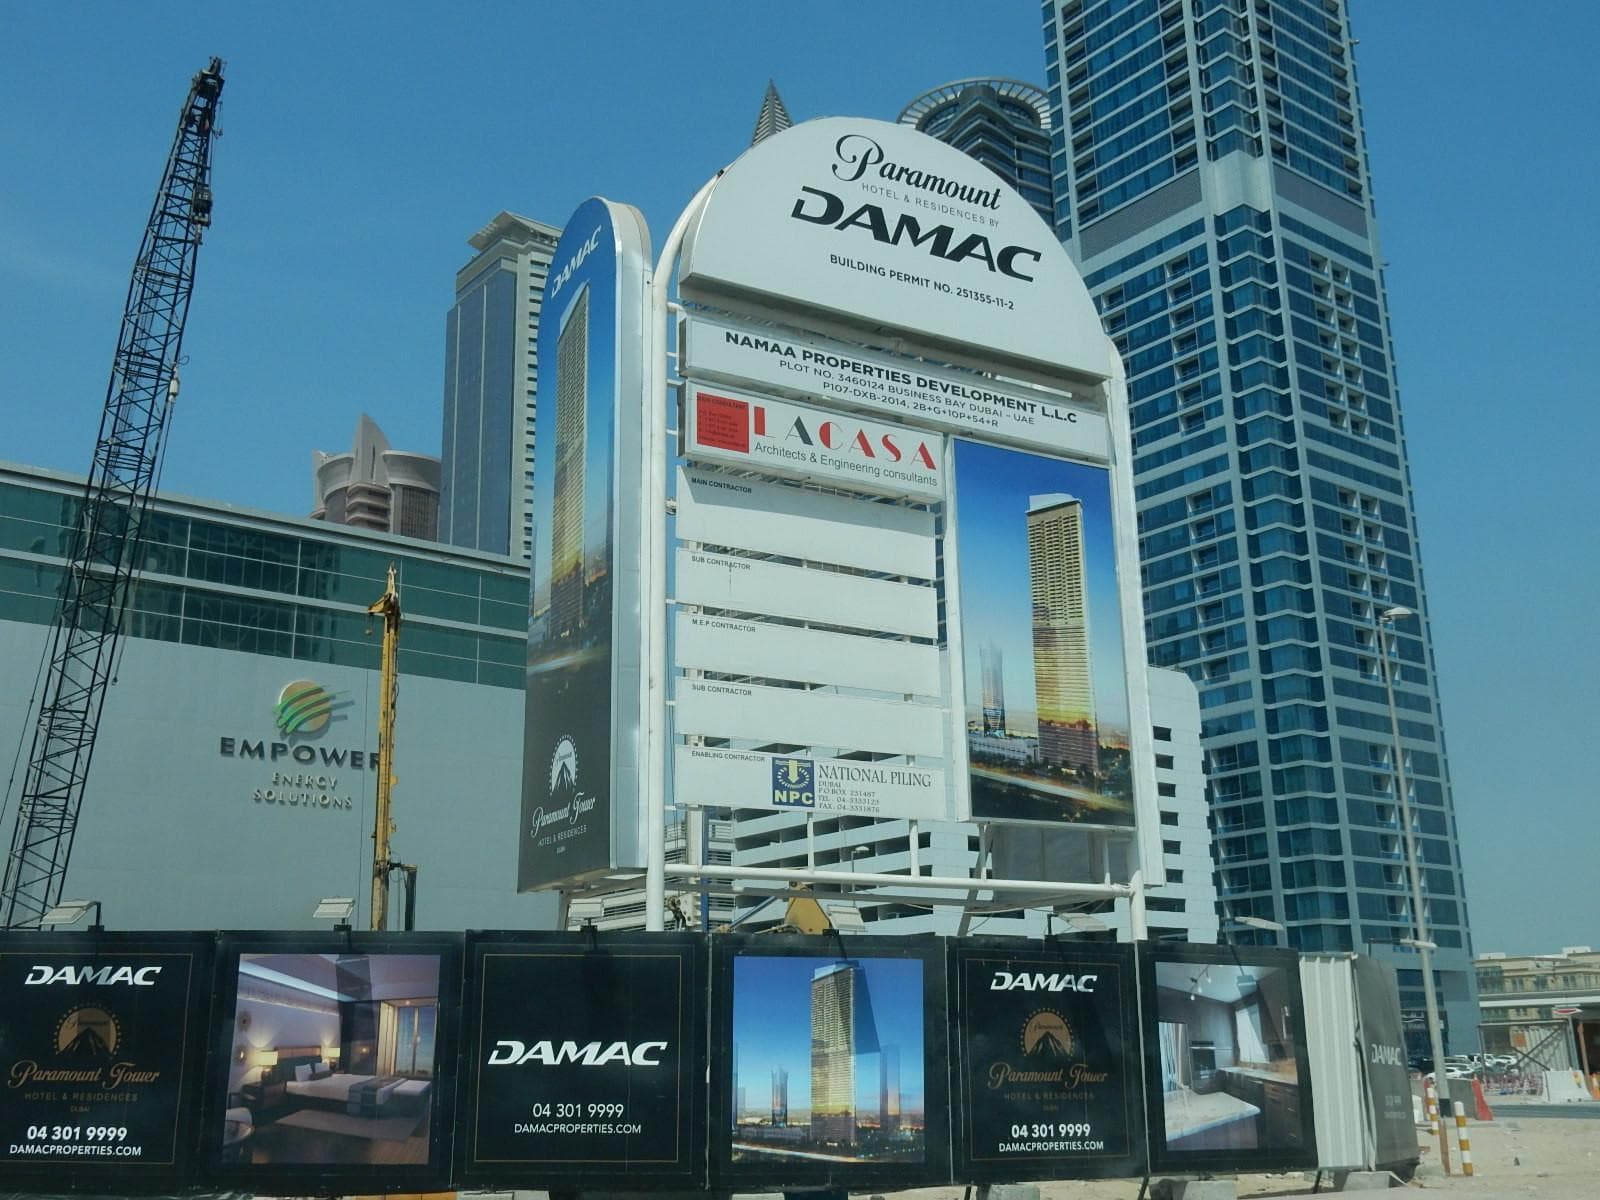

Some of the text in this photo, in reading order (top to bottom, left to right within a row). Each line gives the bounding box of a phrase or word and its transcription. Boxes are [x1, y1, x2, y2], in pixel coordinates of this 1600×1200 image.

[831, 134, 1001, 210] Paramount
[861, 182, 1000, 229] HOTEL & RESIDENCES BY
[790, 185, 1042, 283] DAMAC
[550, 224, 602, 299] DAMAC
[829, 253, 1015, 311] BUILDING PERMIT NO. 251355-11-2
[725, 331, 1078, 424] NAMAA PROPERTIES DEVELOPMENT L.L.C
[779, 359, 811, 374] PLOT
[813, 368, 835, 380] NO.
[837, 373, 885, 392] 3460124
[888, 385, 942, 404] BUSINESS
[944, 398, 966, 410] BAY
[969, 403, 1003, 418] DUBAI
[1013, 413, 1035, 425] UAE
[823, 381, 999, 428] P107-DXB-2014, 2B+G+10P+54+R
[754, 405, 937, 471] LACASA
[754, 441, 938, 488] Architects & Engineering consultants
[691, 477, 752, 494] MAIN CONTRACTOR
[691, 555, 751, 570] SUB CONTRACTOR
[711, 621, 756, 633] CONTRACTOR
[692, 683, 752, 696] SUB CONTRACTOR
[691, 750, 766, 762] ENABLING CONTRACTOR
[272, 772, 337, 789] ENERGY
[818, 763, 932, 788] NATIONAL PILING
[254, 789, 353, 809] SOLUTIONS
[774, 789, 814, 805] NPC
[831, 788, 847, 796] BOX
[25, 965, 162, 986] DAMAC
[990, 972, 1098, 993] DAMAC
[488, 1040, 668, 1066] DAMAC
[7, 1060, 160, 1090] Paramount Tower
[987, 1062, 1109, 1089] Paramount Tower
[24, 1092, 57, 1101] HOTEL
[72, 1092, 139, 1102] RESIDENCES
[532, 1103, 625, 1118] 04 301 9999
[27, 1126, 128, 1141] 04 301 9999
[514, 1123, 642, 1134] DAMACPROPERTIES.COM
[1011, 1123, 1091, 1139] 04 301 9999
[9, 1144, 142, 1156] DAMACPROPERTIES.COM
[999, 1141, 1104, 1153] DAMACPROPERTIES.COM
